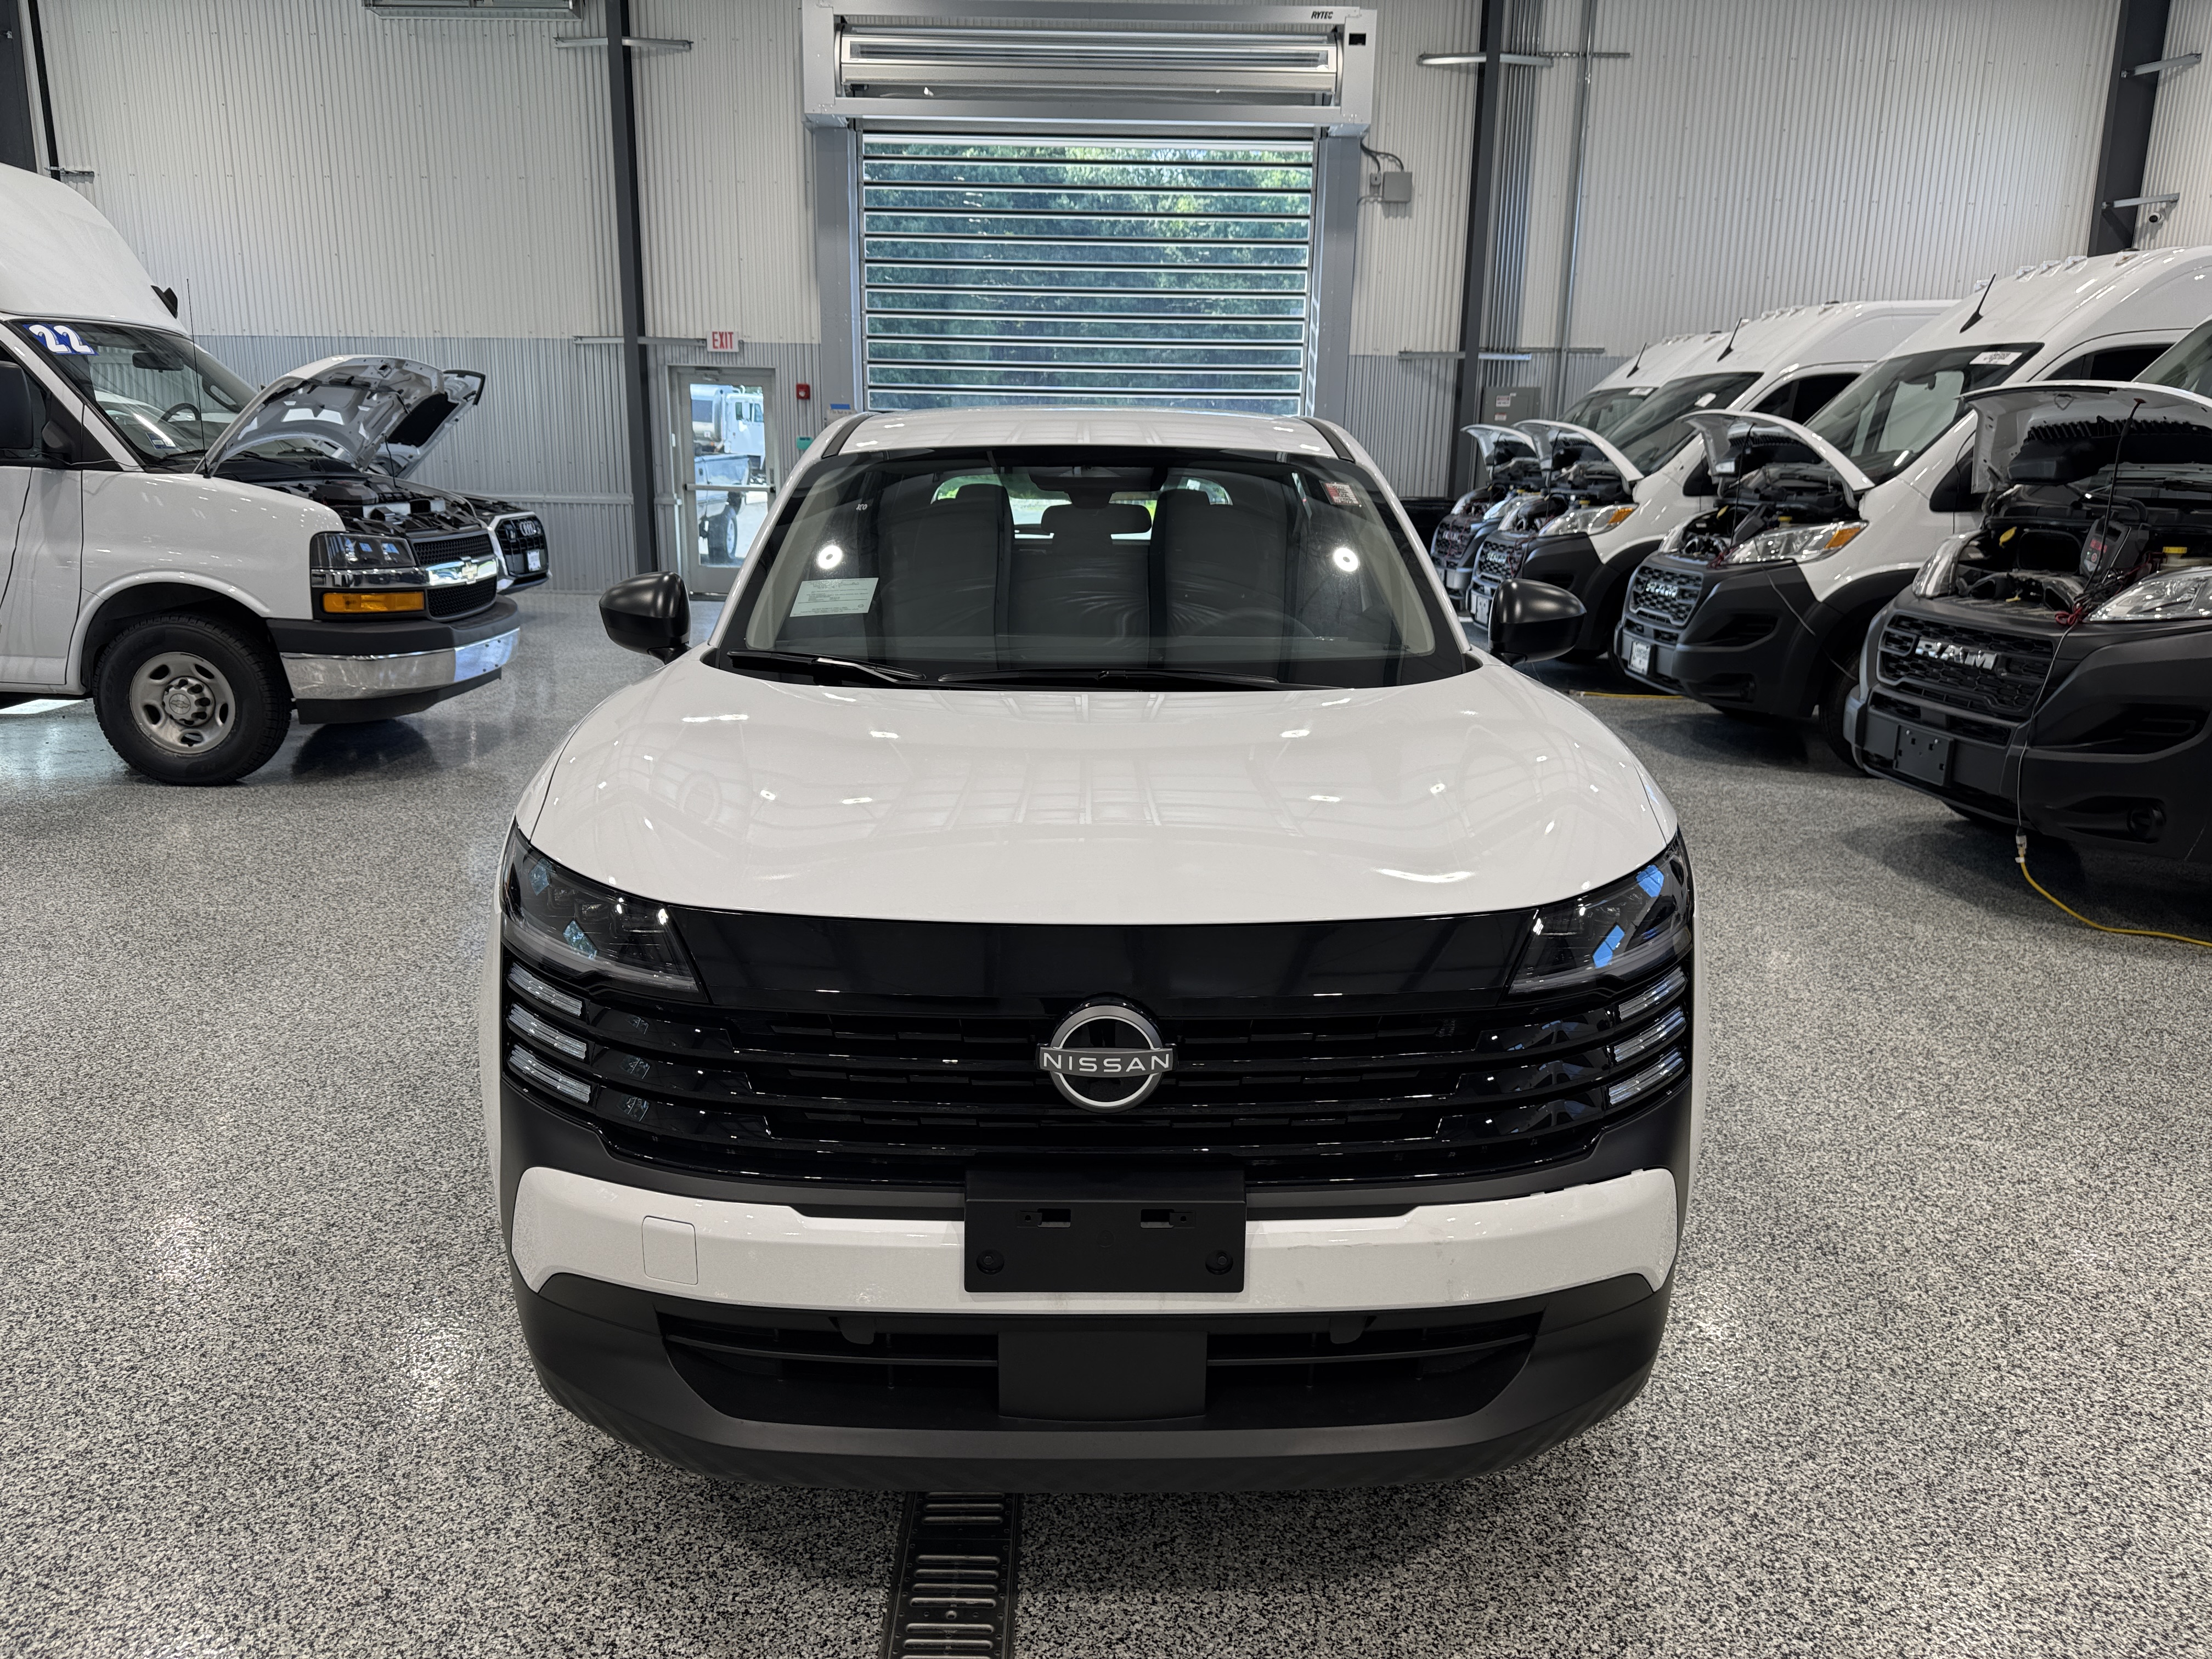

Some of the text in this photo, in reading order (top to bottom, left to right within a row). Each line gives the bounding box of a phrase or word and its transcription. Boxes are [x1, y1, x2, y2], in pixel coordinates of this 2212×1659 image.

[1311, 11, 1333, 19] RYTEC
[29, 325, 95, 354] 22
[712, 331, 733, 349] EXIT
[1915, 640, 1997, 670] RAM
[1043, 1052, 1170, 1073] NISSAN
